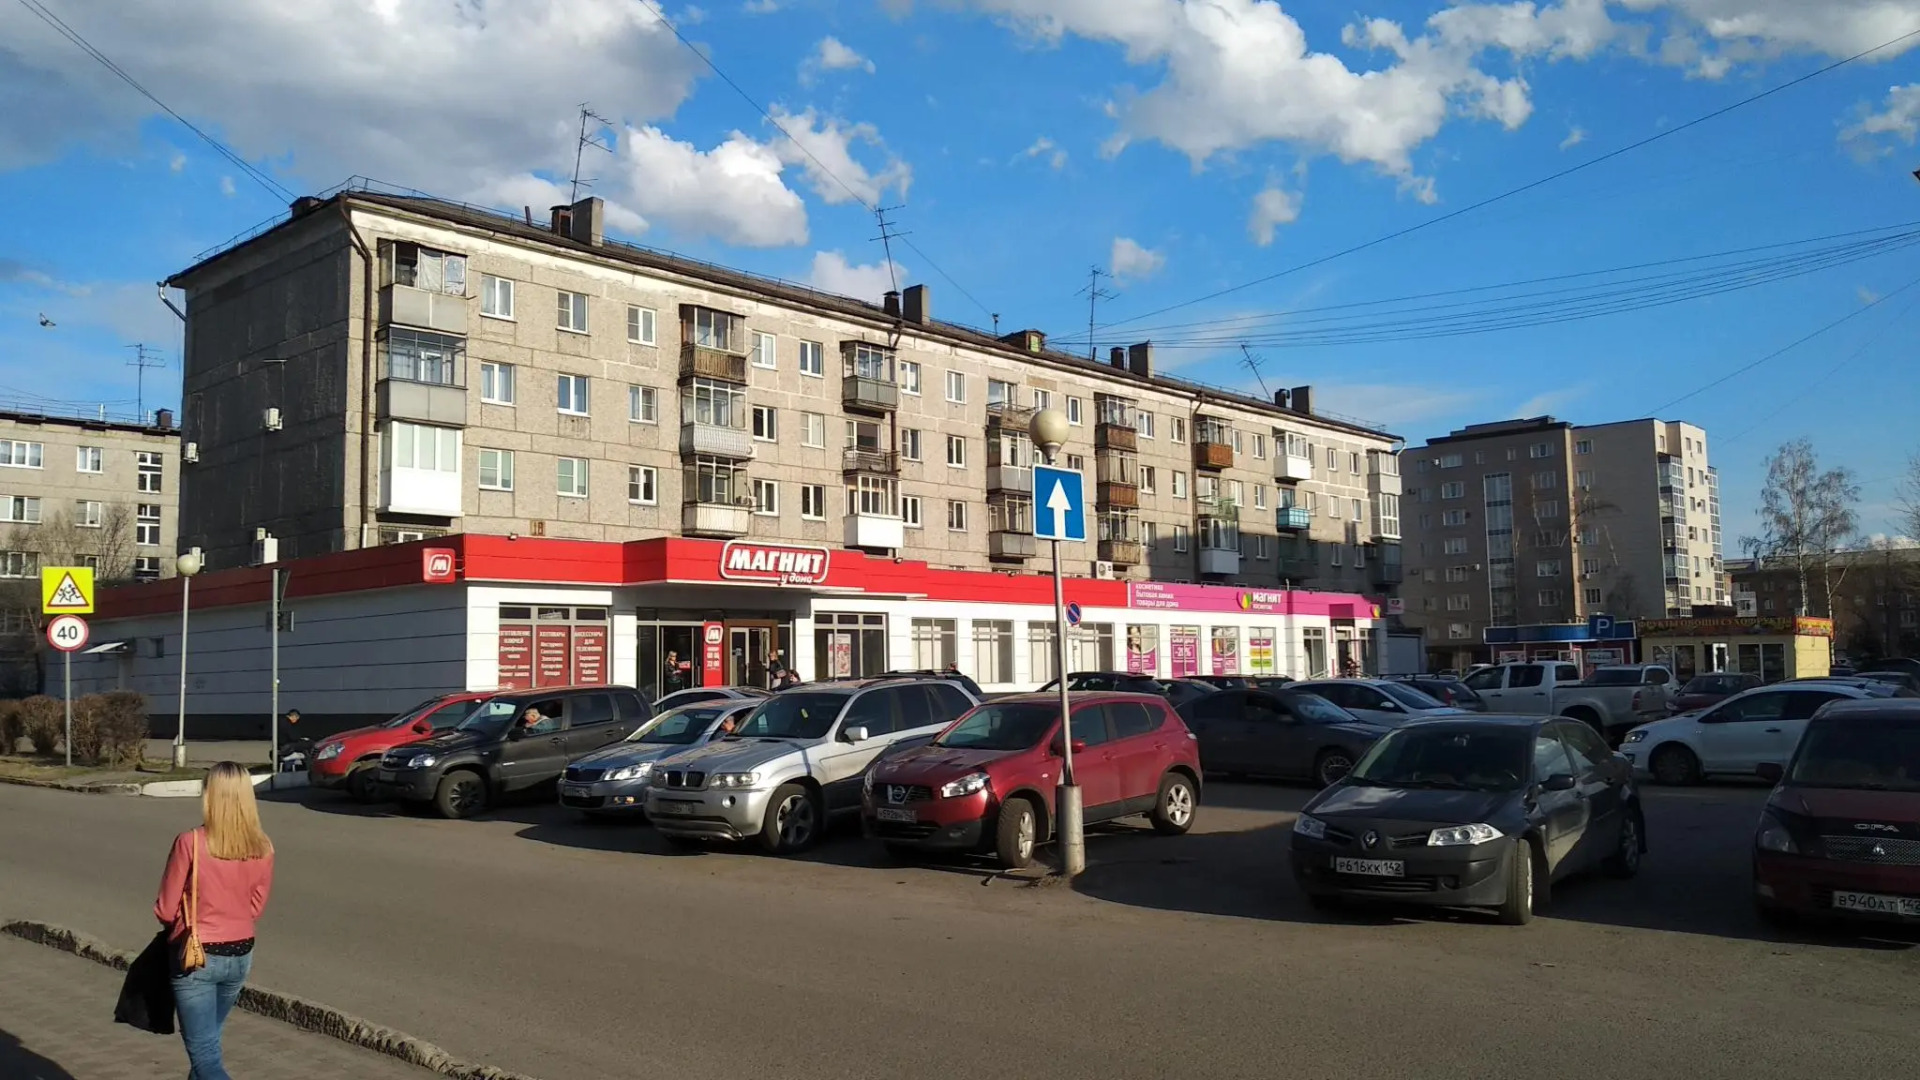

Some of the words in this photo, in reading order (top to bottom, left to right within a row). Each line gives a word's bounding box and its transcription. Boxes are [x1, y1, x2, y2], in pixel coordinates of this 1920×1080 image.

[728, 548, 824, 574] МАГНИТ
[781, 574, 788, 584] у
[789, 572, 813, 584] дома
[1136, 599, 1156, 607] товары
[1252, 591, 1282, 604] магнит
[1596, 618, 1610, 634] P
[1638, 619, 1678, 628] ФРУКТЫ
[1680, 618, 1718, 627] ОВОЩИ
[57, 625, 78, 640] 40
[1340, 860, 1381, 873] Р616КК
[1384, 862, 1401, 872] 142
[1839, 895, 1895, 910] В940АТ
